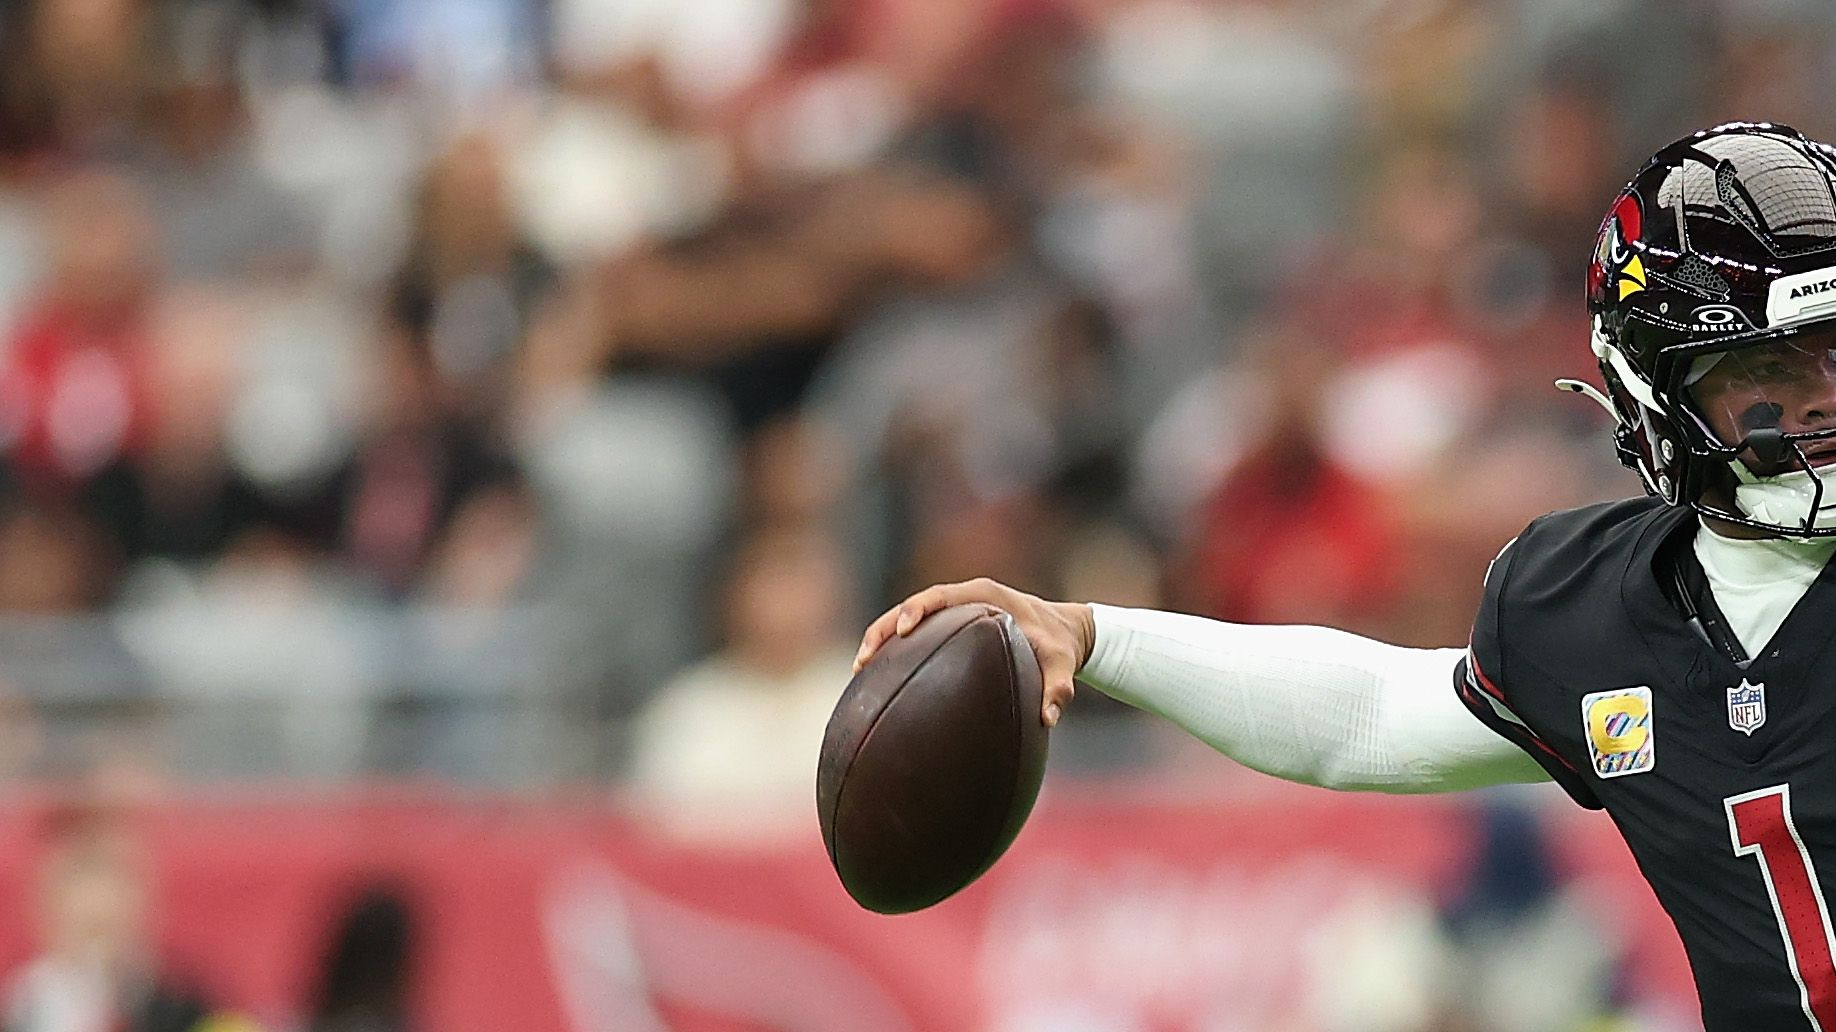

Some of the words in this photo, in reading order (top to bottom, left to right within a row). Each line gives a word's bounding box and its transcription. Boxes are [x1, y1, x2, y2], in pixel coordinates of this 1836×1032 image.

[1692, 323, 1744, 332] OAKLEY
[1588, 695, 1649, 754] C
[1735, 704, 1760, 725] NFL
